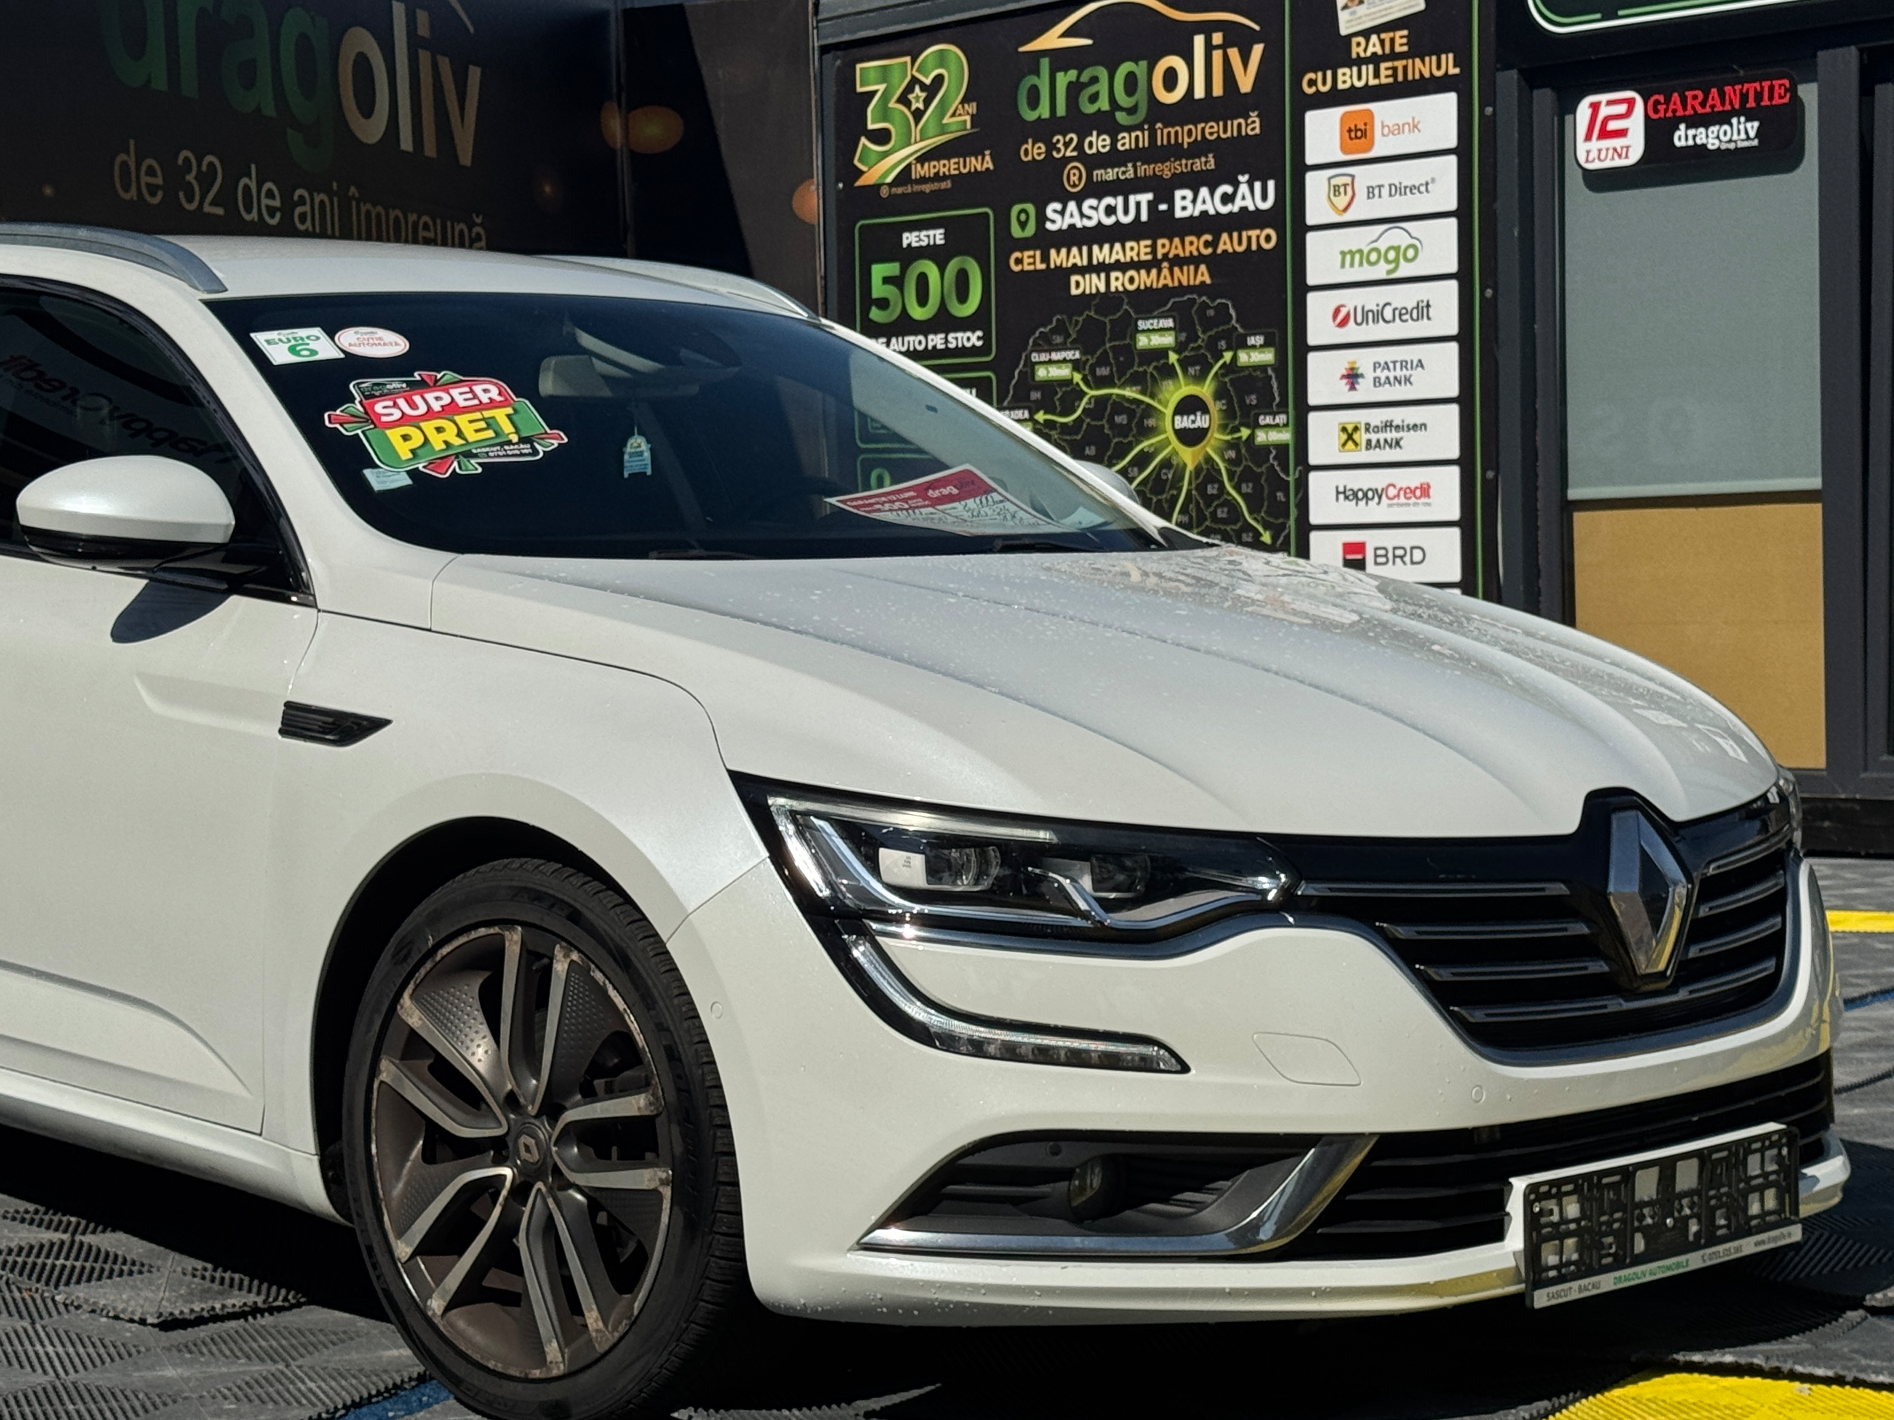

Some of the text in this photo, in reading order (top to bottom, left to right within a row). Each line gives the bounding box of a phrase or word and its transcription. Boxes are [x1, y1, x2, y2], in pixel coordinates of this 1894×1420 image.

[1351, 29, 1409, 59] RATE
[1017, 32, 1265, 126] dragoliv
[1301, 53, 1461, 95] CU BULETINUL
[853, 43, 970, 174] 32
[955, 101, 978, 118] ANI
[1647, 78, 1790, 120] GARANTIE
[1346, 122, 1368, 142] tbi
[1380, 116, 1421, 138] bank
[1583, 97, 1636, 143] 12
[1673, 116, 1760, 150] dragoliv
[1019, 111, 1261, 162] de 32 de ani împreună
[911, 150, 994, 180] ÎMPREUNĂ
[1584, 145, 1632, 163] LUNI
[1092, 154, 1216, 184] marcă înregistrată
[114, 139, 164, 205] de
[178, 149, 224, 216] 32
[237, 164, 281, 226] de
[293, 182, 340, 238] ani
[1332, 182, 1350, 198] BT
[1366, 184, 1385, 201] BT
[1045, 197, 1154, 232] SASCUT
[1174, 179, 1276, 219] BACĂU
[902, 228, 946, 249] PESTE
[1009, 228, 1278, 273] CEL MAI MARE PARC AUTO
[1339, 242, 1420, 276] mogo
[868, 255, 983, 324] 500
[1070, 261, 1211, 296] DIN ROMÂNIA
[1137, 318, 1174, 330] SUCEAVA
[1353, 299, 1432, 327] UniCredit
[264, 334, 321, 346] EURO
[287, 342, 319, 358] 6
[870, 330, 984, 352] E AUTO PE STOC
[1372, 358, 1426, 373] PATRIA
[1372, 374, 1413, 388] BANK
[374, 383, 504, 422] SUPER
[1174, 411, 1210, 429] BACĂU
[1364, 419, 1428, 435] Raiffeisen
[385, 407, 519, 461] PREȚ
[1364, 437, 1404, 451] BANK
[1335, 482, 1432, 507] HappyCredit
[1373, 546, 1426, 566] BRD
[1546, 1286, 1573, 1302] SASCUT
